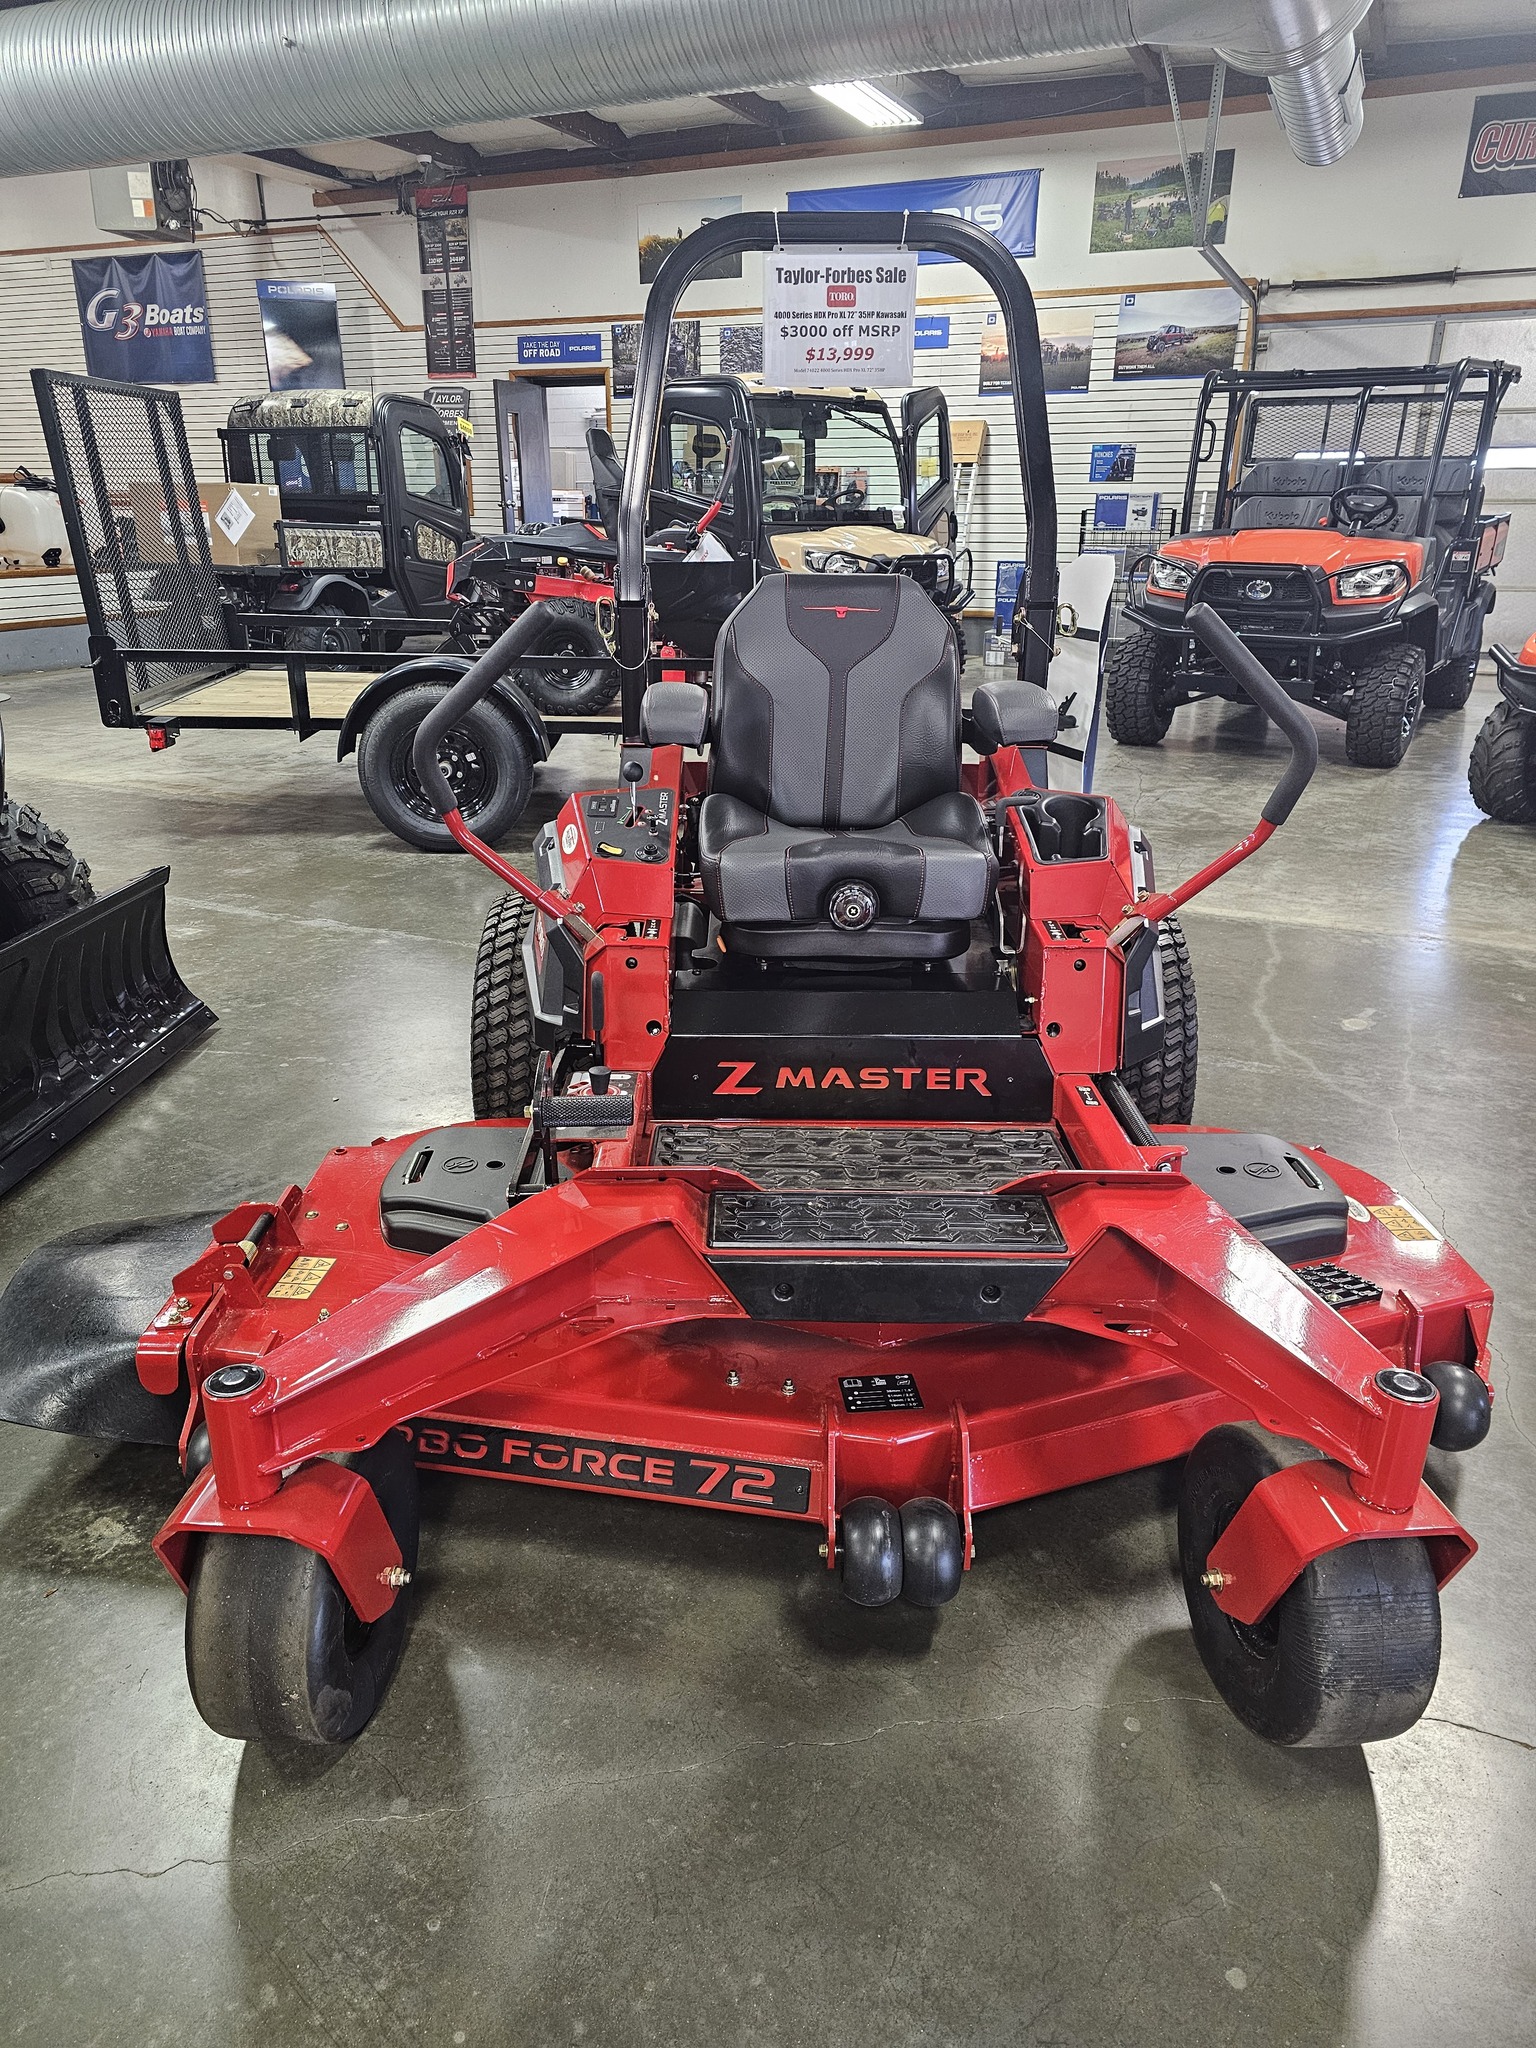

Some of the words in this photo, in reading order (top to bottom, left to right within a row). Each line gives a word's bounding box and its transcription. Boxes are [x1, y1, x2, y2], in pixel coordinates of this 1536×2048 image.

[776, 267, 873, 285] Taylor-Forbes
[876, 266, 907, 284] Sale
[829, 292, 853, 301] TORO
[144, 304, 204, 326] Boats
[774, 311, 791, 319] 4000
[792, 311, 813, 319] Series
[814, 311, 827, 319] HDX
[827, 311, 838, 319] Pro
[839, 311, 847, 319] XL
[847, 311, 858, 319] 72"
[858, 310, 875, 319] 35HP
[876, 310, 907, 319] Kawasaki
[151, 327, 173, 337] YAMAHA
[173, 326, 186, 336] BOAT
[186, 326, 206, 335] COMPANY
[780, 325, 828, 340] $3000
[832, 324, 854, 337] off
[858, 324, 901, 337] MSRP
[914, 329, 943, 337] OLARIS
[523, 349, 538, 358] OFF
[539, 348, 561, 357] ROAD
[805, 347, 875, 363] $13,999
[1272, 476, 1307, 486] Kubota
[1264, 511, 1300, 520] Kubota
[659, 791, 669, 819] MASTER
[713, 1062, 763, 1095] Z
[775, 1067, 992, 1096] MASTER
[501, 1437, 675, 1487] FORCE
[689, 1458, 777, 1504] 72
